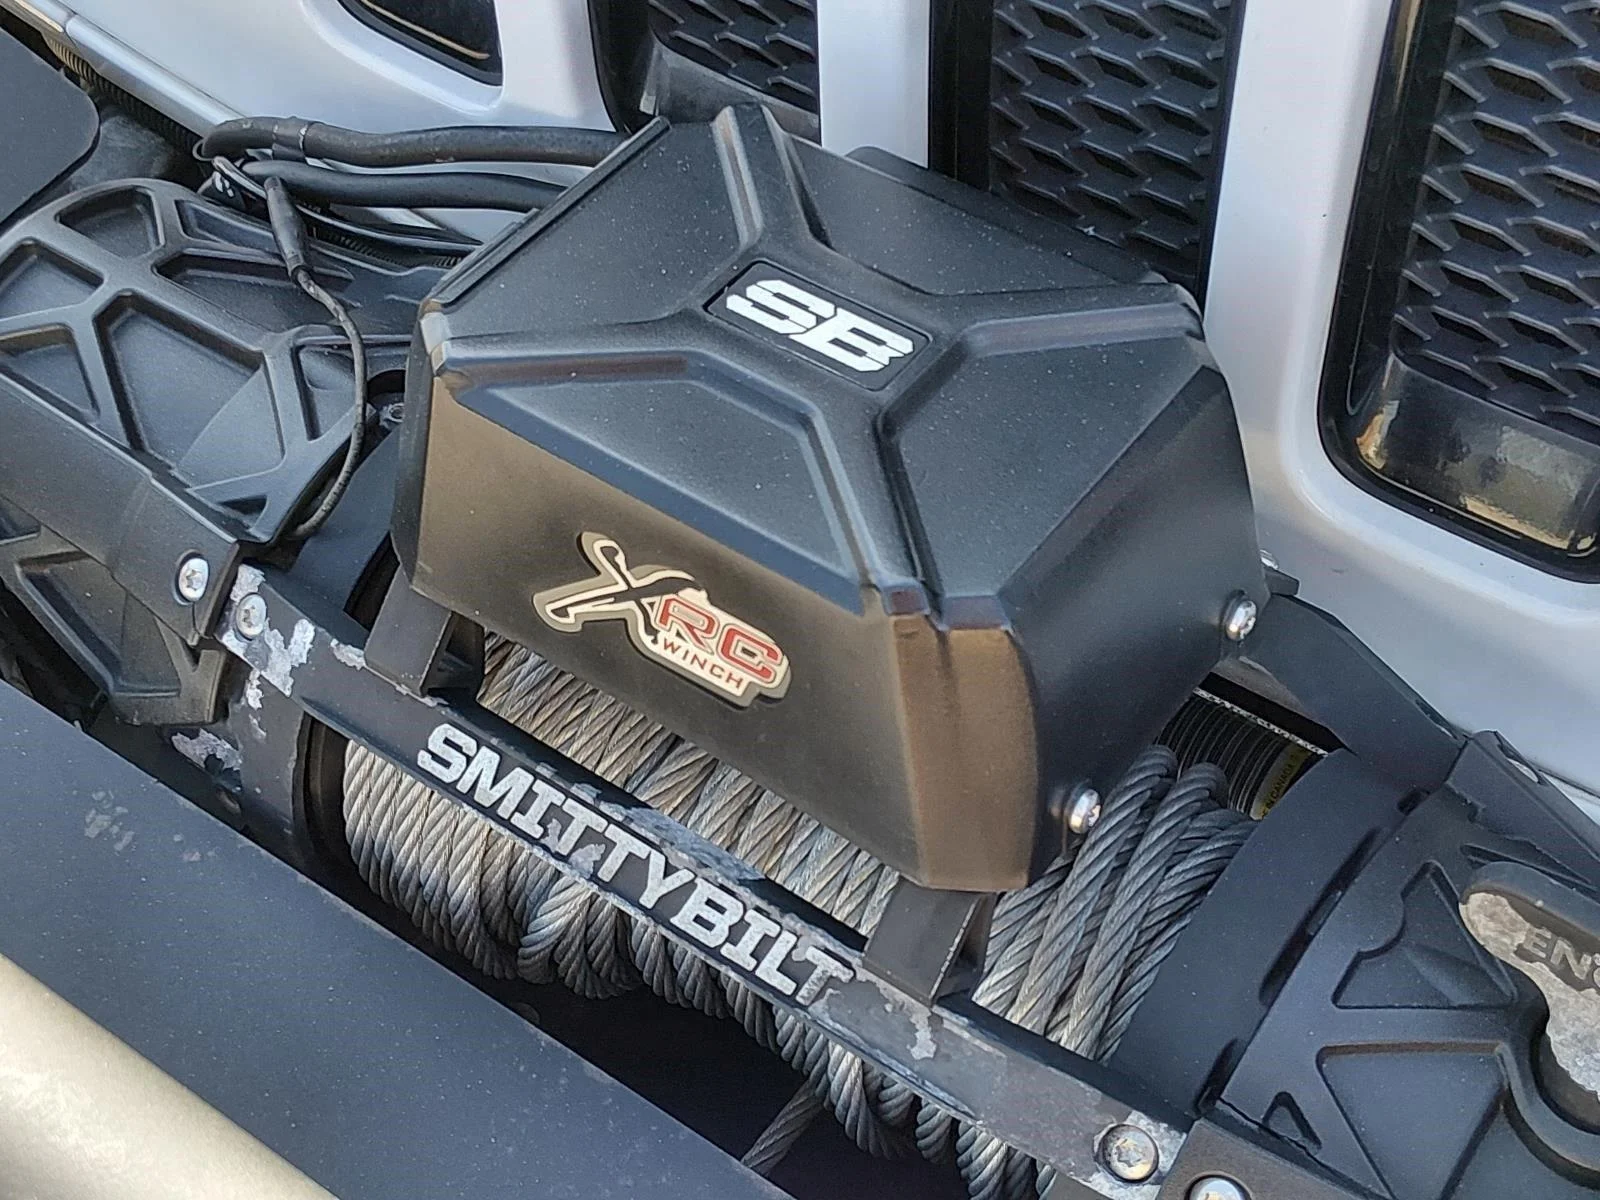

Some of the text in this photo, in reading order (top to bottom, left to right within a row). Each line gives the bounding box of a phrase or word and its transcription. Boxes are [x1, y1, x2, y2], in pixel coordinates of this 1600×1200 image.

[543, 538, 783, 685] XRC
[663, 637, 744, 689] WINCH
[417, 723, 855, 1006] SMITTYBILT
